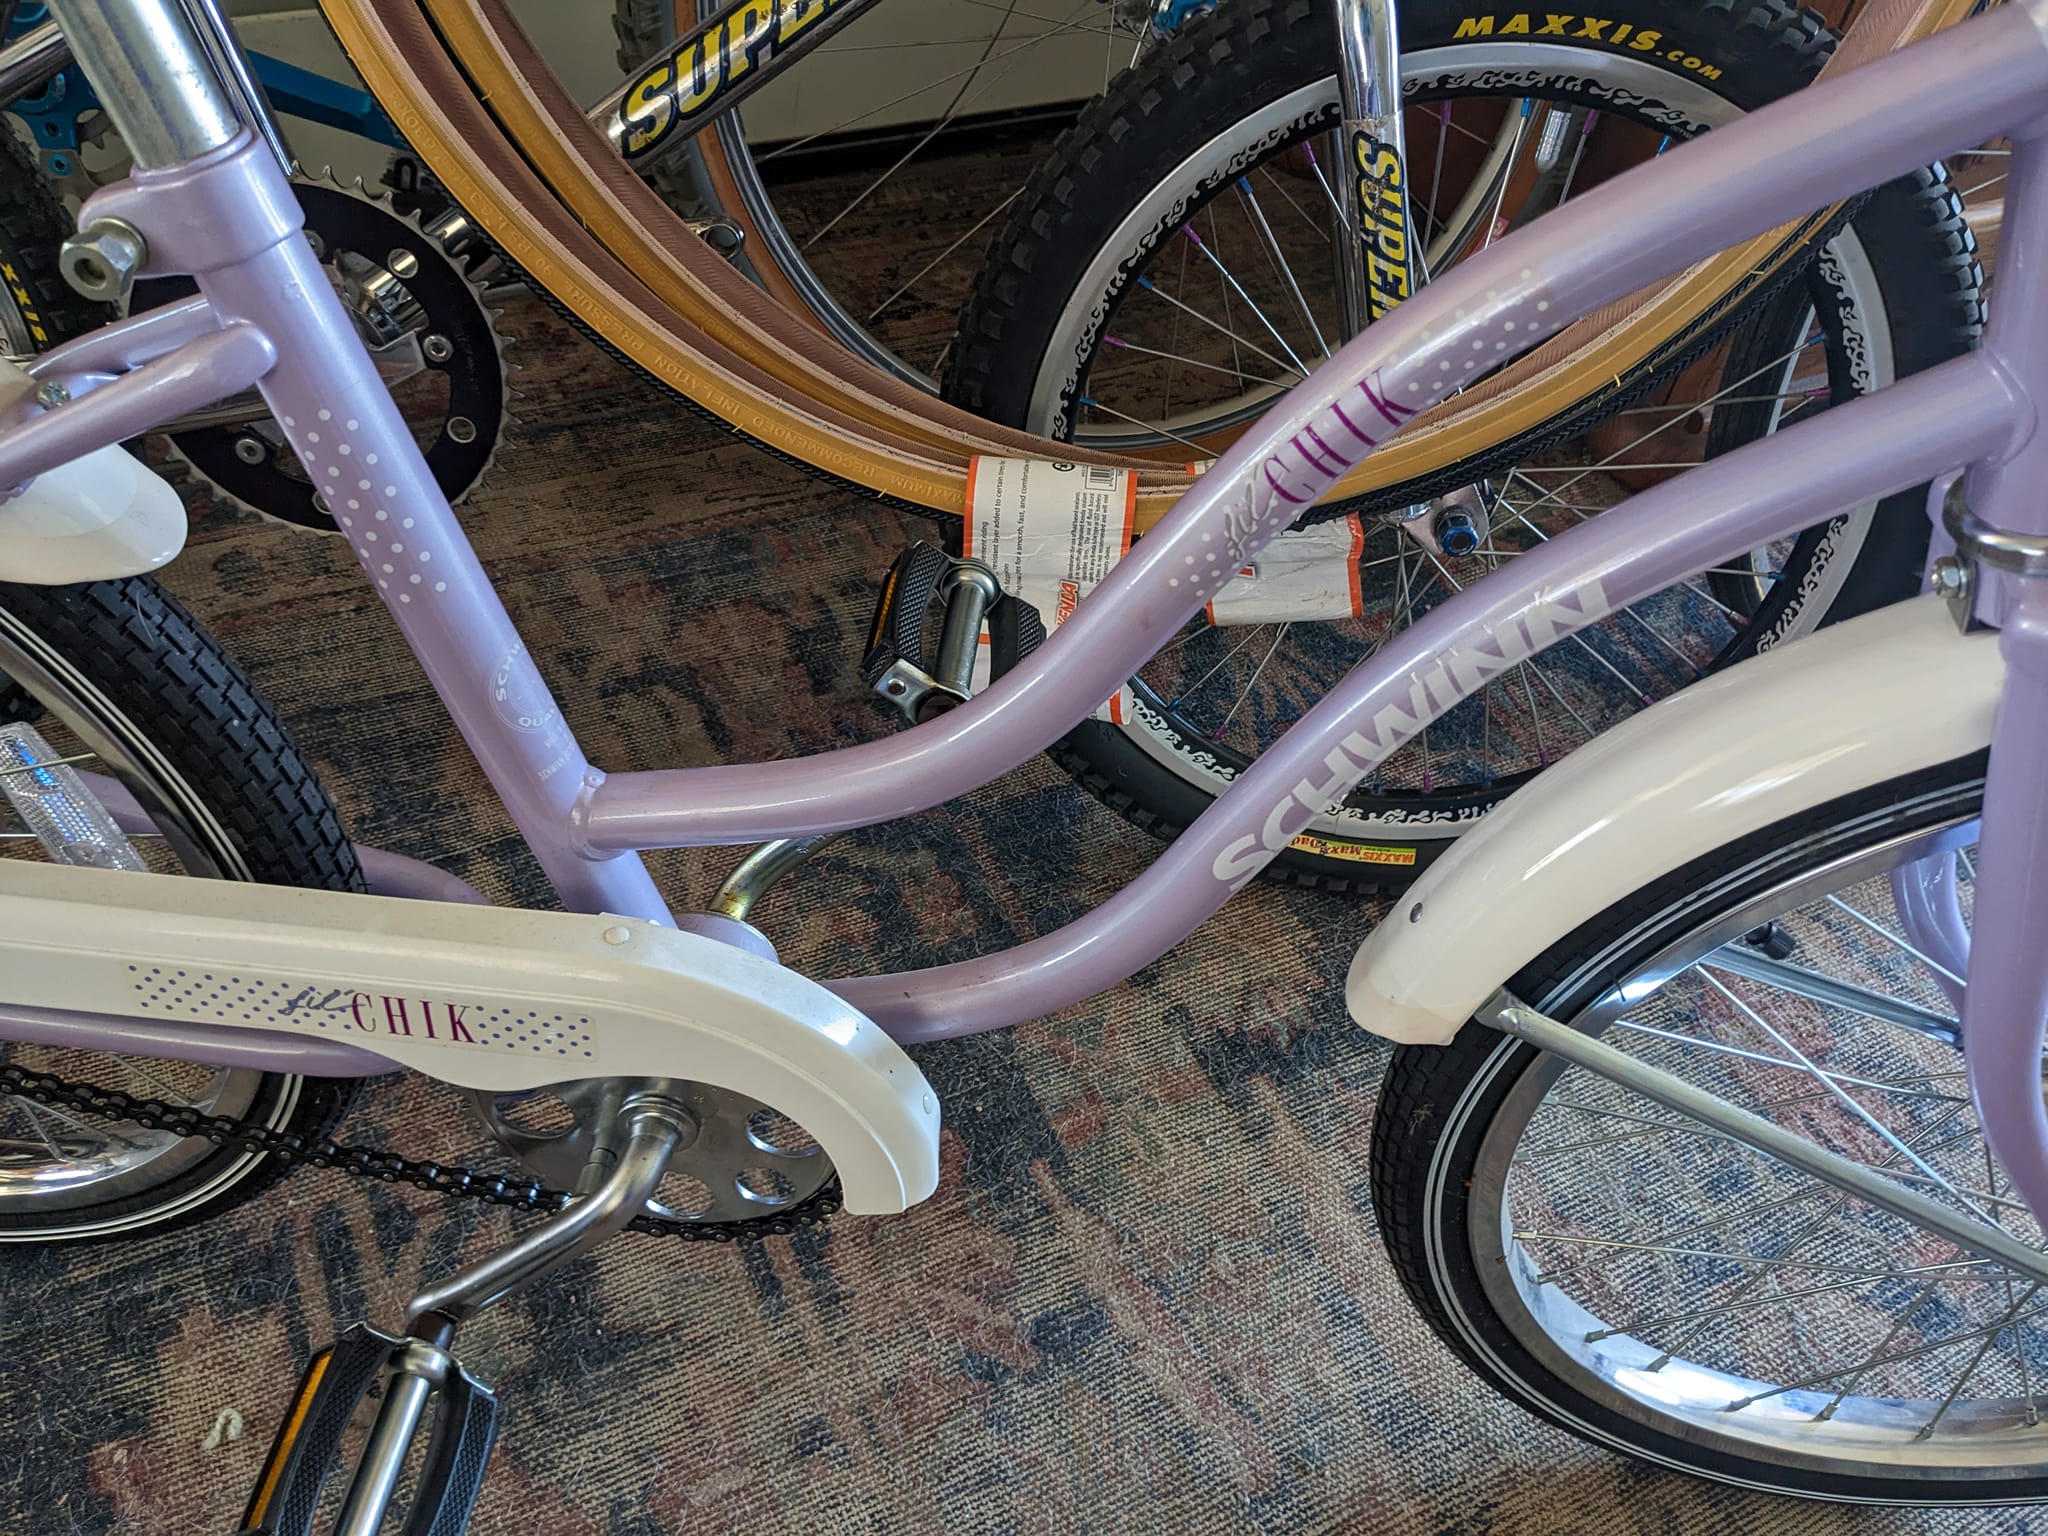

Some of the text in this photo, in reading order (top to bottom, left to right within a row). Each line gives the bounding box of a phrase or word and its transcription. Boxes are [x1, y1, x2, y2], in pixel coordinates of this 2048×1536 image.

[654, 355, 741, 416] INFLATION
[752, 415, 876, 478] RECOMMENDED
[1264, 367, 1419, 504] CHIK
[995, 476, 1004, 498] certain
[1019, 495, 1027, 509] and
[993, 508, 1001, 529] added
[1212, 576, 1613, 892] SCHWINN
[352, 991, 478, 1044] CHIK
